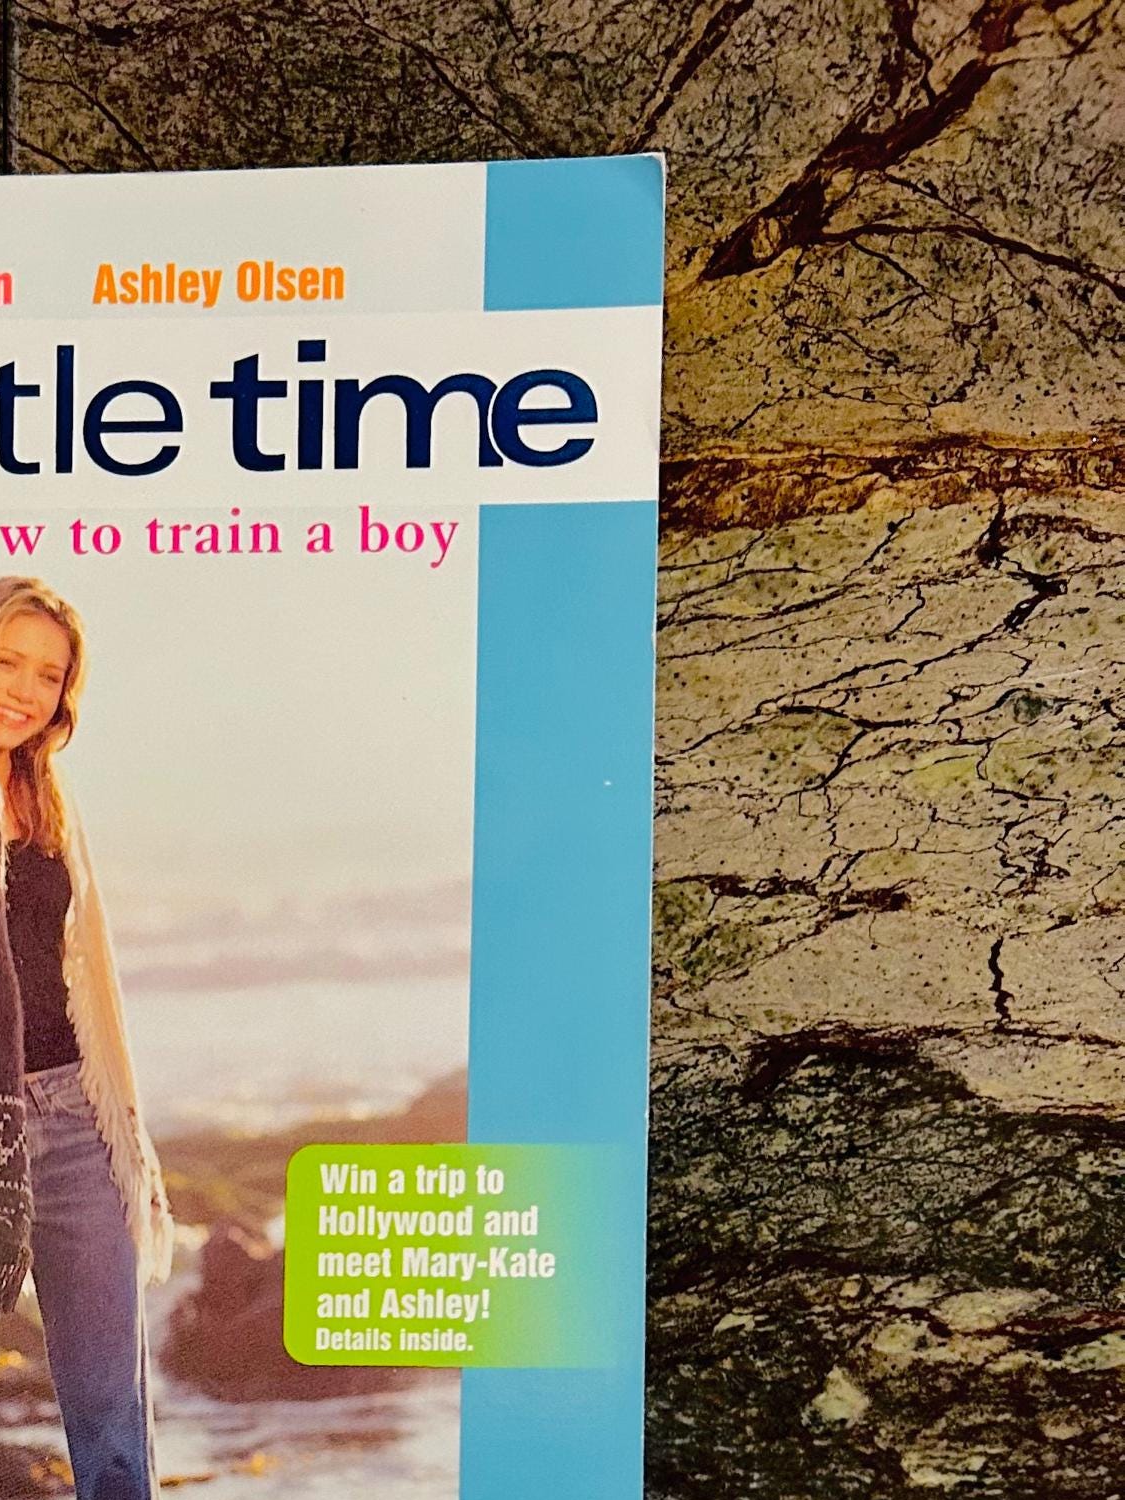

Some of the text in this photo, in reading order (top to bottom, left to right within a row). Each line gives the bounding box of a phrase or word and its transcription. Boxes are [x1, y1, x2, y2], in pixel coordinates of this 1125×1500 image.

[92, 259, 345, 308] Ashley Olsen
[210, 339, 598, 472] time
[69, 514, 120, 556] to
[148, 502, 282, 555] train
[306, 520, 335, 554] a
[359, 505, 460, 570] boy
[320, 1163, 505, 1198] Win a trip to
[318, 1205, 539, 1240] Hollywood and
[317, 1247, 556, 1282] meet Mary-Kate
[317, 1289, 490, 1323] and Ashley!
[315, 1328, 474, 1352] Details inside.
